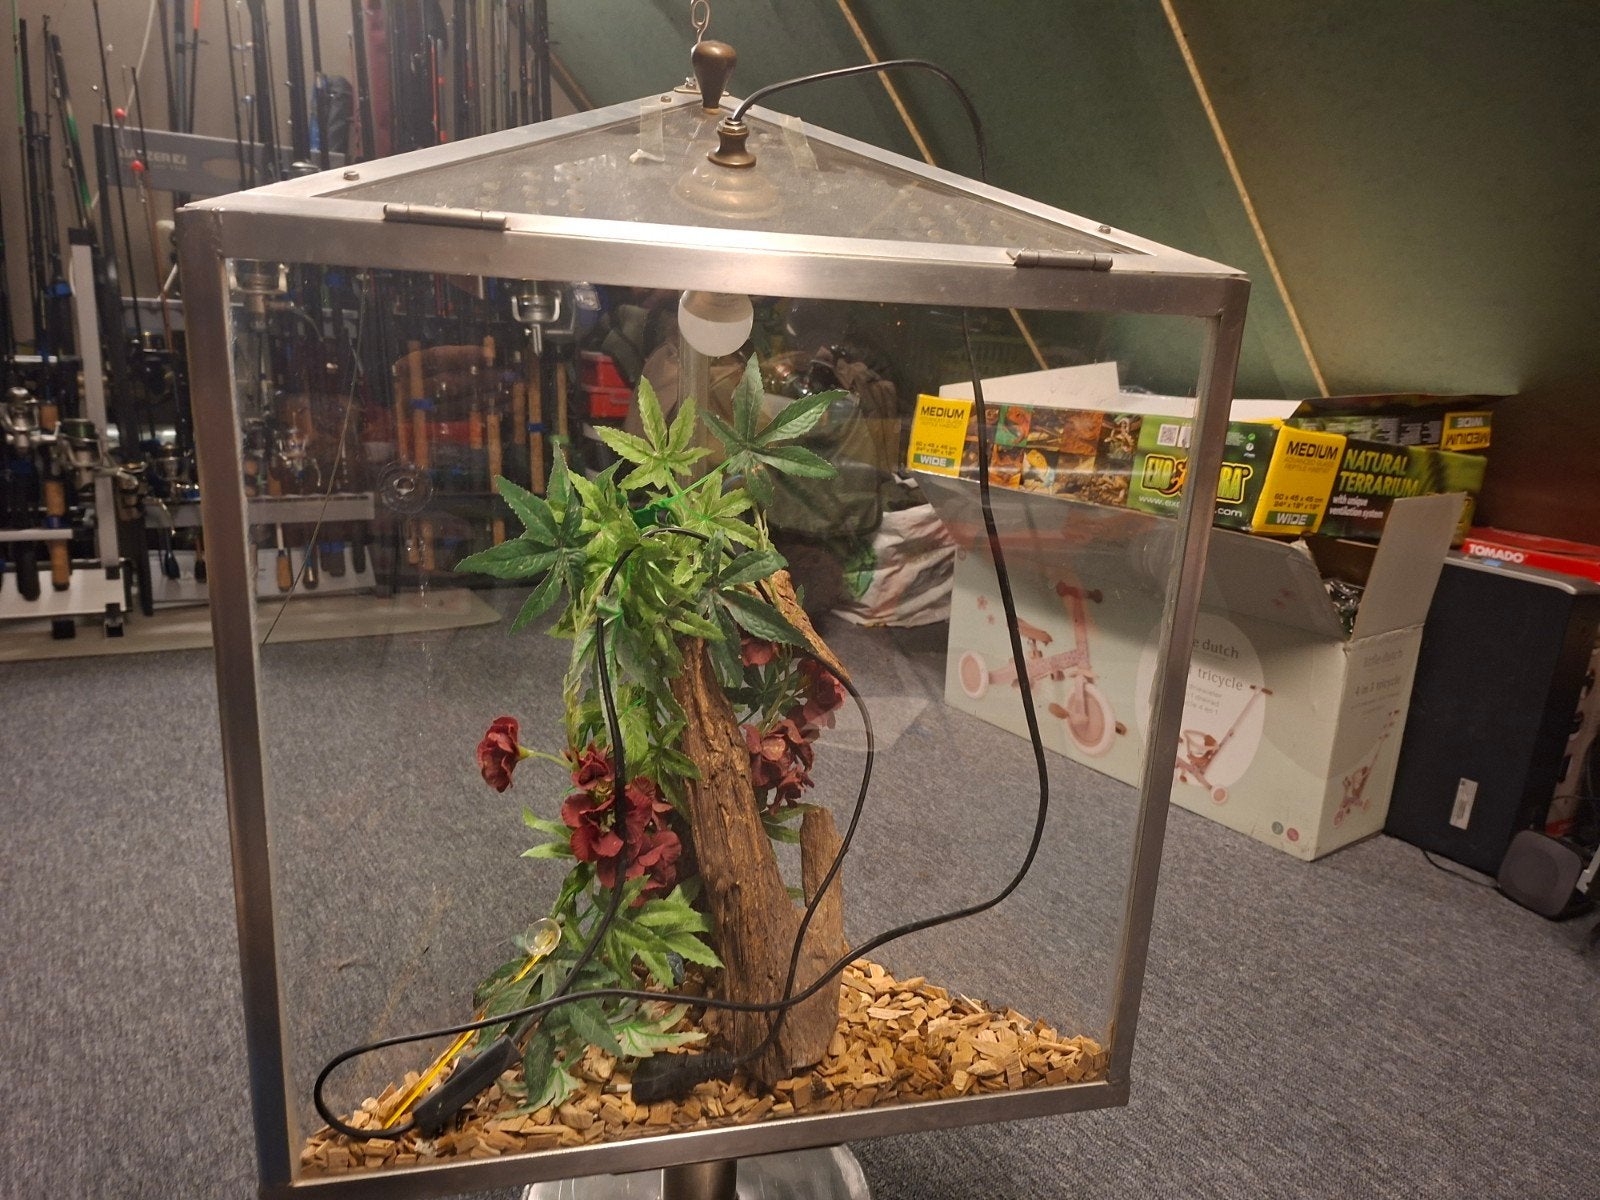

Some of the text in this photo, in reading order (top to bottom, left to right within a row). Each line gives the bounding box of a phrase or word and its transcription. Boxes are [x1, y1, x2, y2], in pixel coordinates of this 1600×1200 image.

[920, 406, 964, 420] MEDIUM
[920, 454, 948, 467] WIDE
[1286, 440, 1339, 461] MEDIUM
[1343, 448, 1408, 477] NATURAL
[1142, 457, 1174, 490] EXO
[1339, 470, 1420, 498] TERRARIUM
[1276, 512, 1309, 526] WIDE
[1469, 544, 1524, 564] TOMADO
[1203, 638, 1240, 659] dutch
[1198, 668, 1243, 691] tricycle
